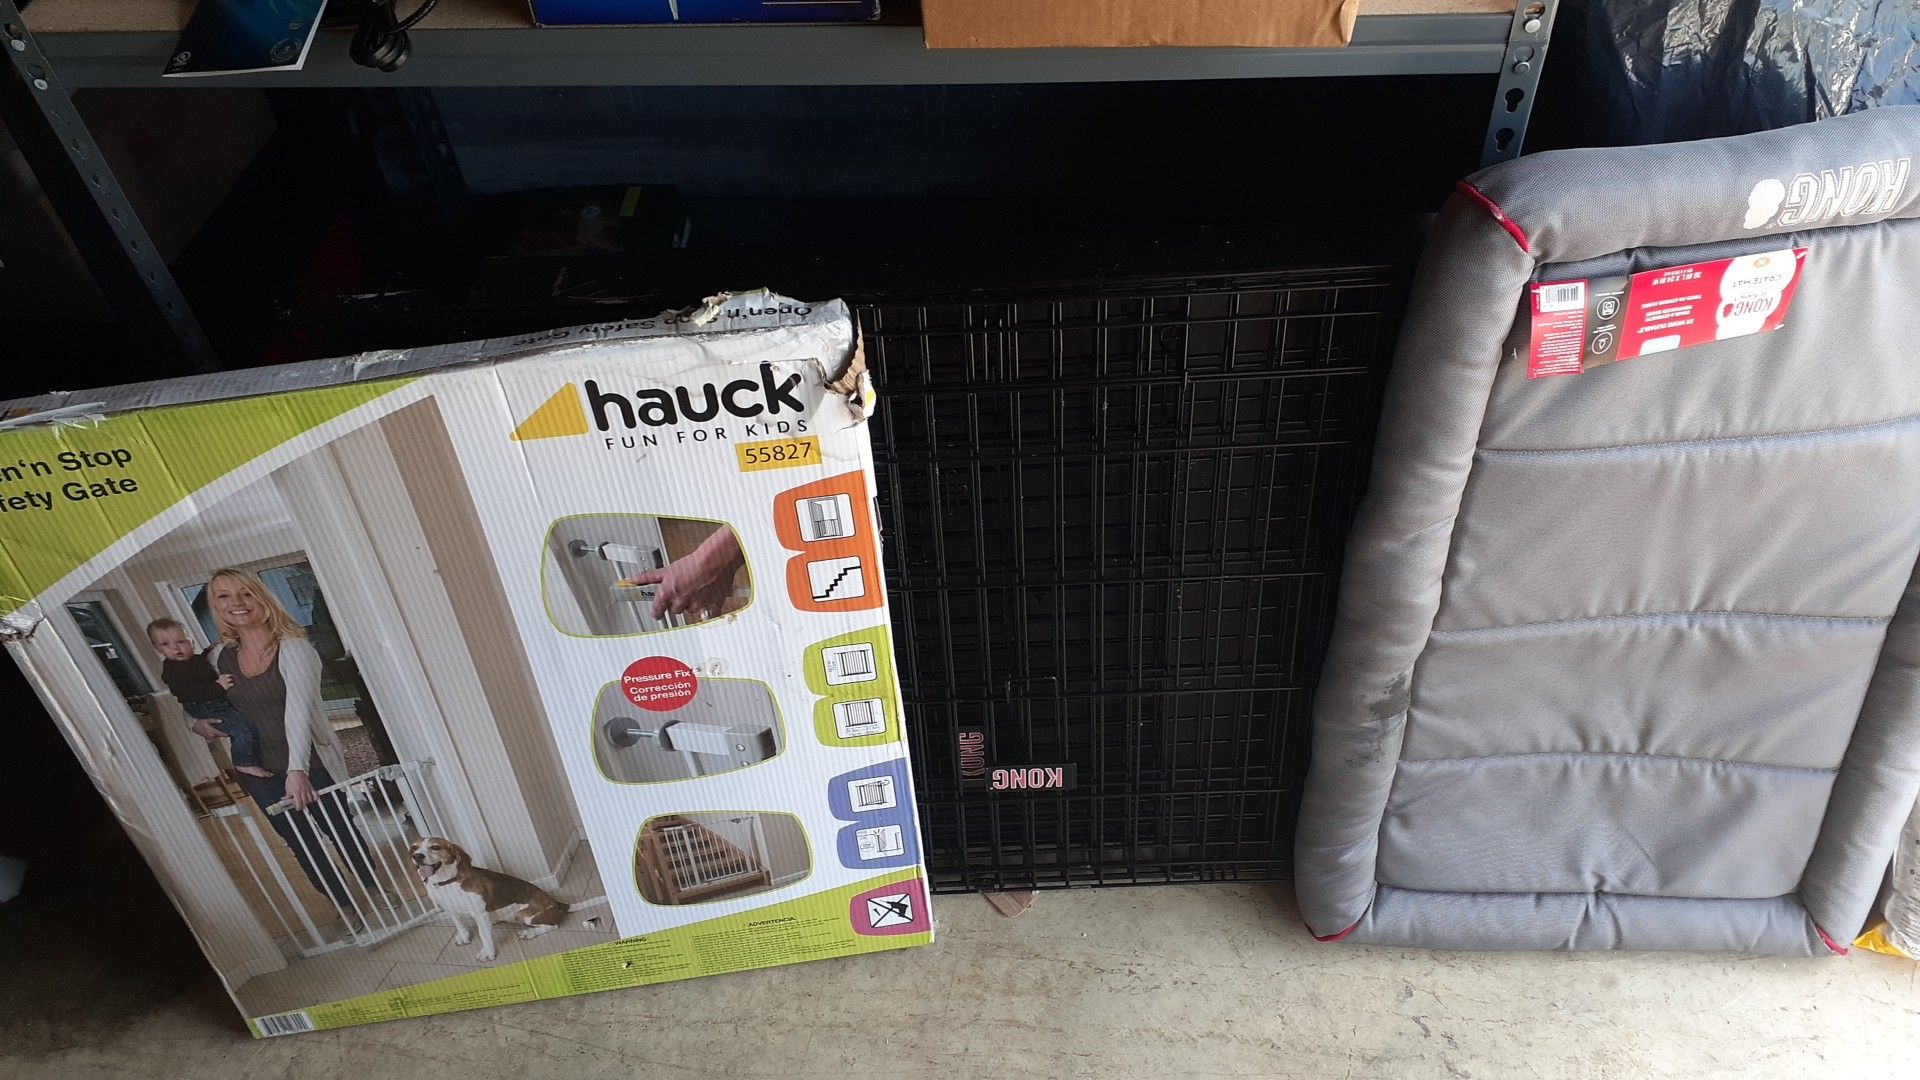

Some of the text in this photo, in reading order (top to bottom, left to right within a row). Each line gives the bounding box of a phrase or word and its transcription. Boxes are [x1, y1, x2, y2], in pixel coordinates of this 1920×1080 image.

[1777, 157, 1911, 226] KONG
[1731, 274, 1782, 288] CRATE MAT
[1734, 298, 1773, 316] KONG
[578, 320, 655, 336] Safety
[584, 360, 806, 431] hauck
[605, 418, 808, 450] FUN FOR KIDS
[745, 443, 812, 464] 55827
[0, 448, 132, 482] n'n Stop
[62, 477, 138, 501] Gate
[623, 669, 691, 684] Pressure Fix
[629, 682, 691, 695] Corrección
[633, 689, 692, 703] de presión
[959, 731, 985, 777] KONG
[992, 767, 1063, 789] KONG
[615, 937, 647, 946] WARNING
